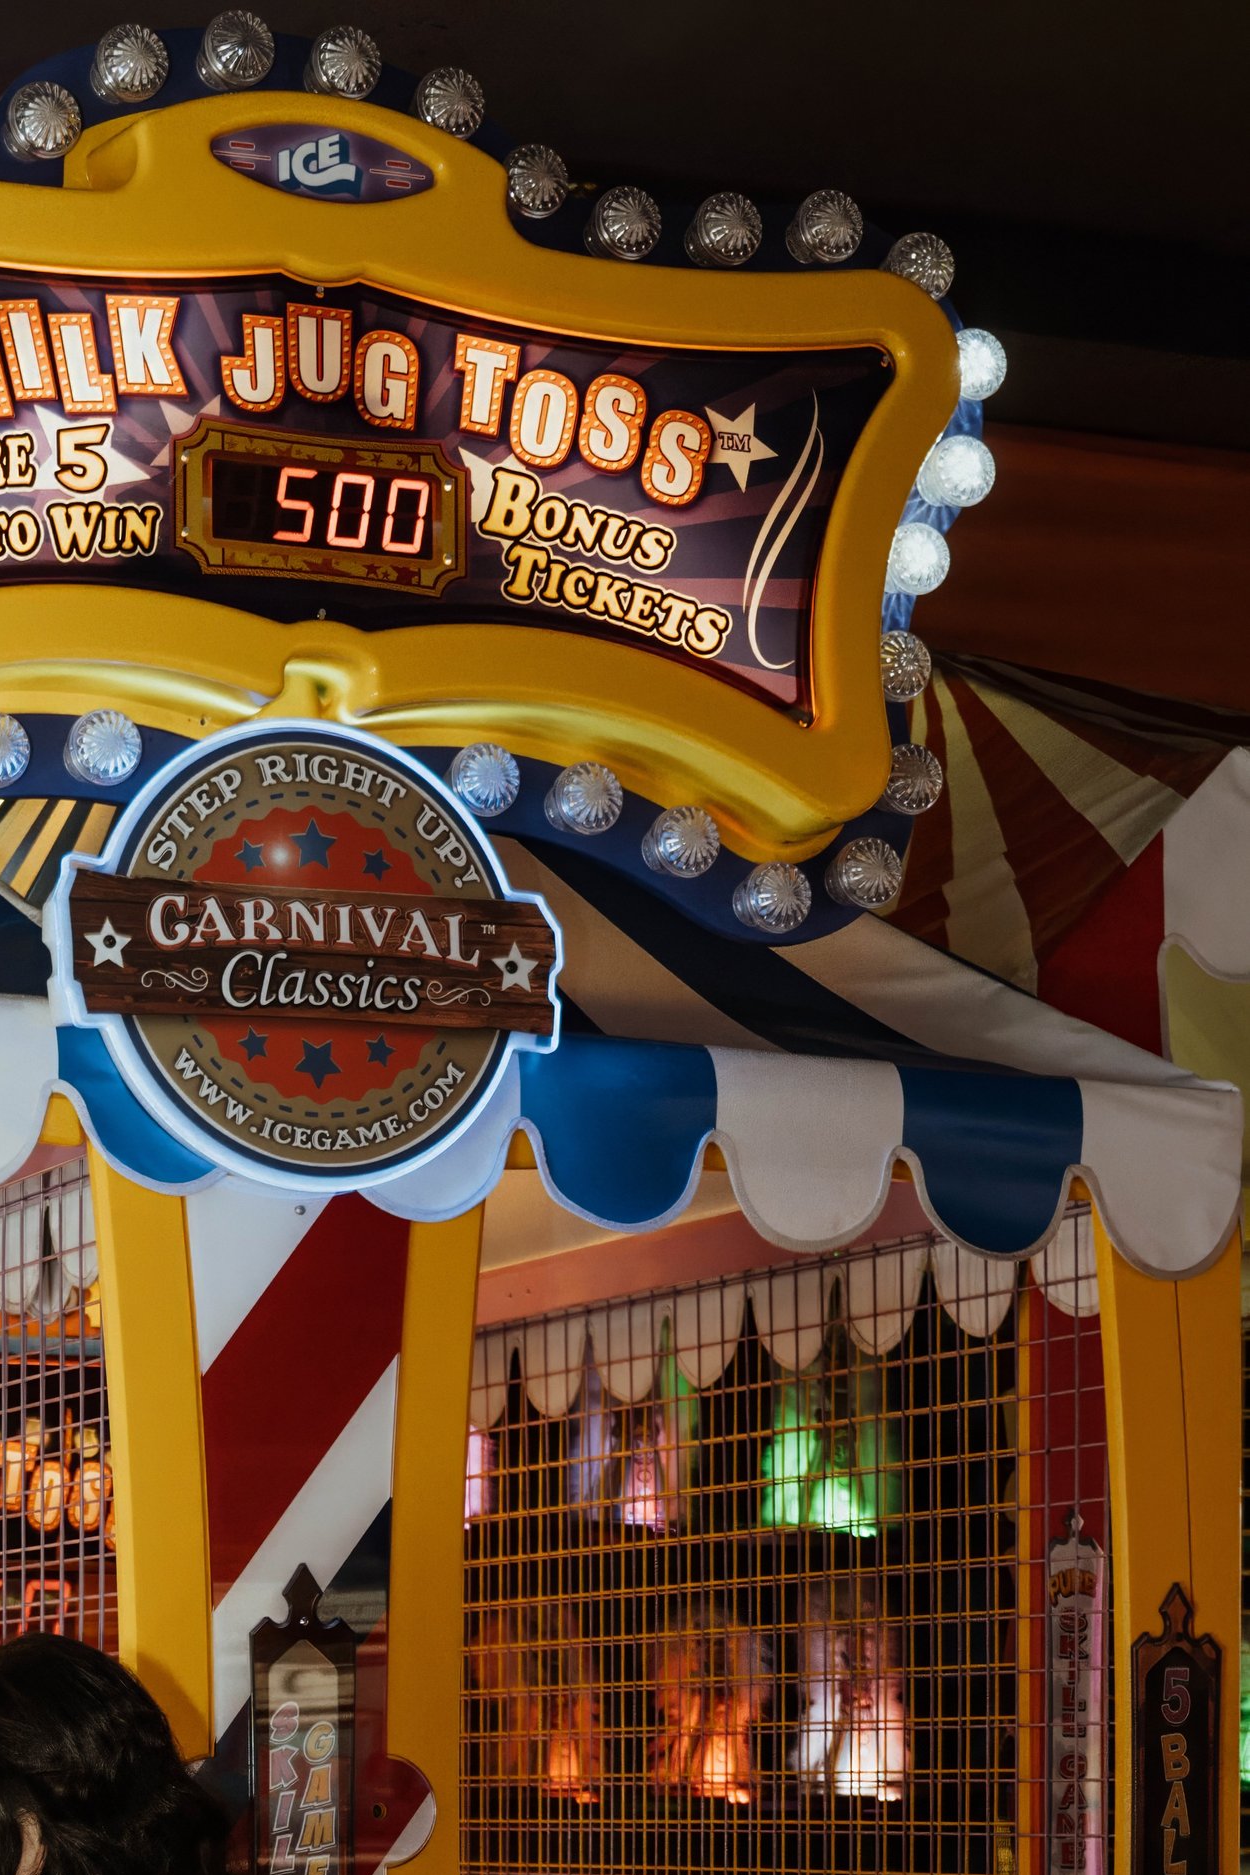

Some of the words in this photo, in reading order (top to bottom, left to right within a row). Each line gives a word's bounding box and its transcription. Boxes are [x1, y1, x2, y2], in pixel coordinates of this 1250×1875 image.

[278, 133, 357, 187] ICE
[220, 302, 421, 430] JUG
[455, 333, 711, 508] TOSS
[55, 423, 109, 493] 5
[275, 467, 429, 553] 500
[146, 769, 243, 871] STEP
[255, 753, 407, 807] RIGHT
[416, 804, 480, 889] UP!
[147, 892, 480, 968] CARNIVAL
[222, 950, 422, 1012] Classics
[174, 1048, 466, 1150] WWW.ICEGAME.COM
[1161, 1667, 1190, 1725] 5
